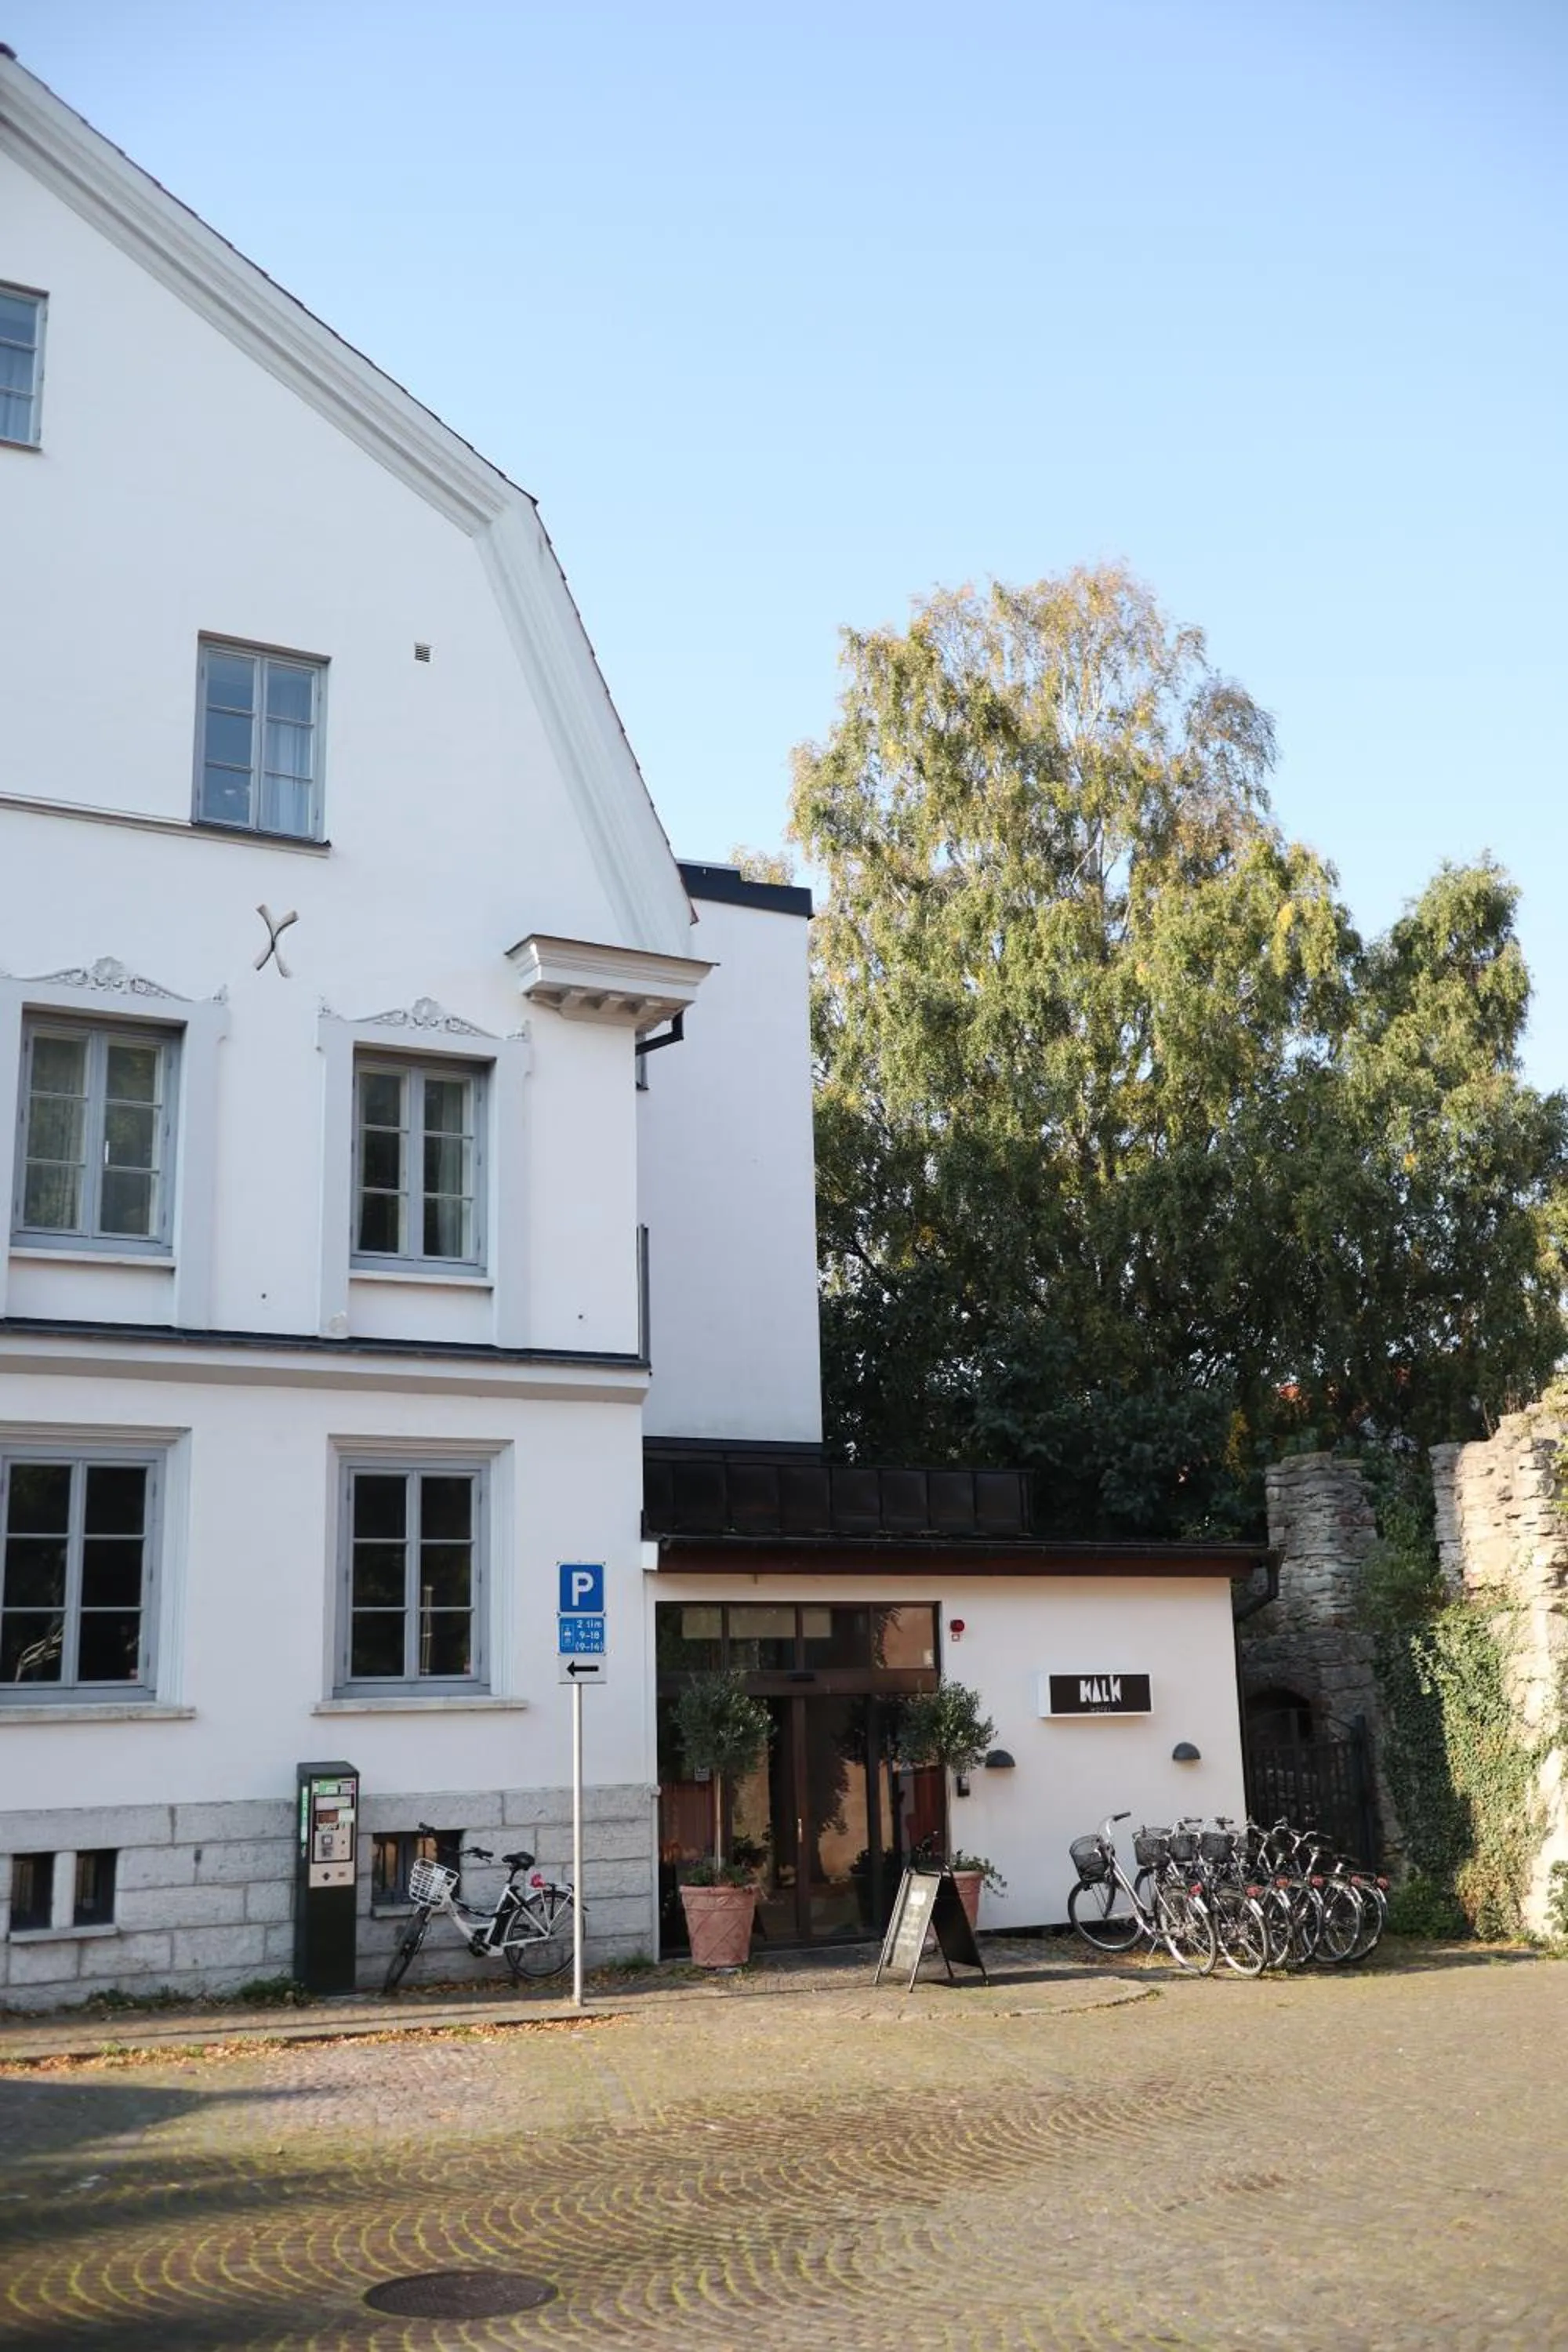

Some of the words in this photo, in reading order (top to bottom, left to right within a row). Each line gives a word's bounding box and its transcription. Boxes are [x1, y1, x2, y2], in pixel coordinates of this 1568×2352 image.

[572, 1571, 594, 1606] P
[577, 1619, 583, 1628] 2
[586, 1619, 603, 1628] tim
[1080, 1675, 1122, 1703] KALK
